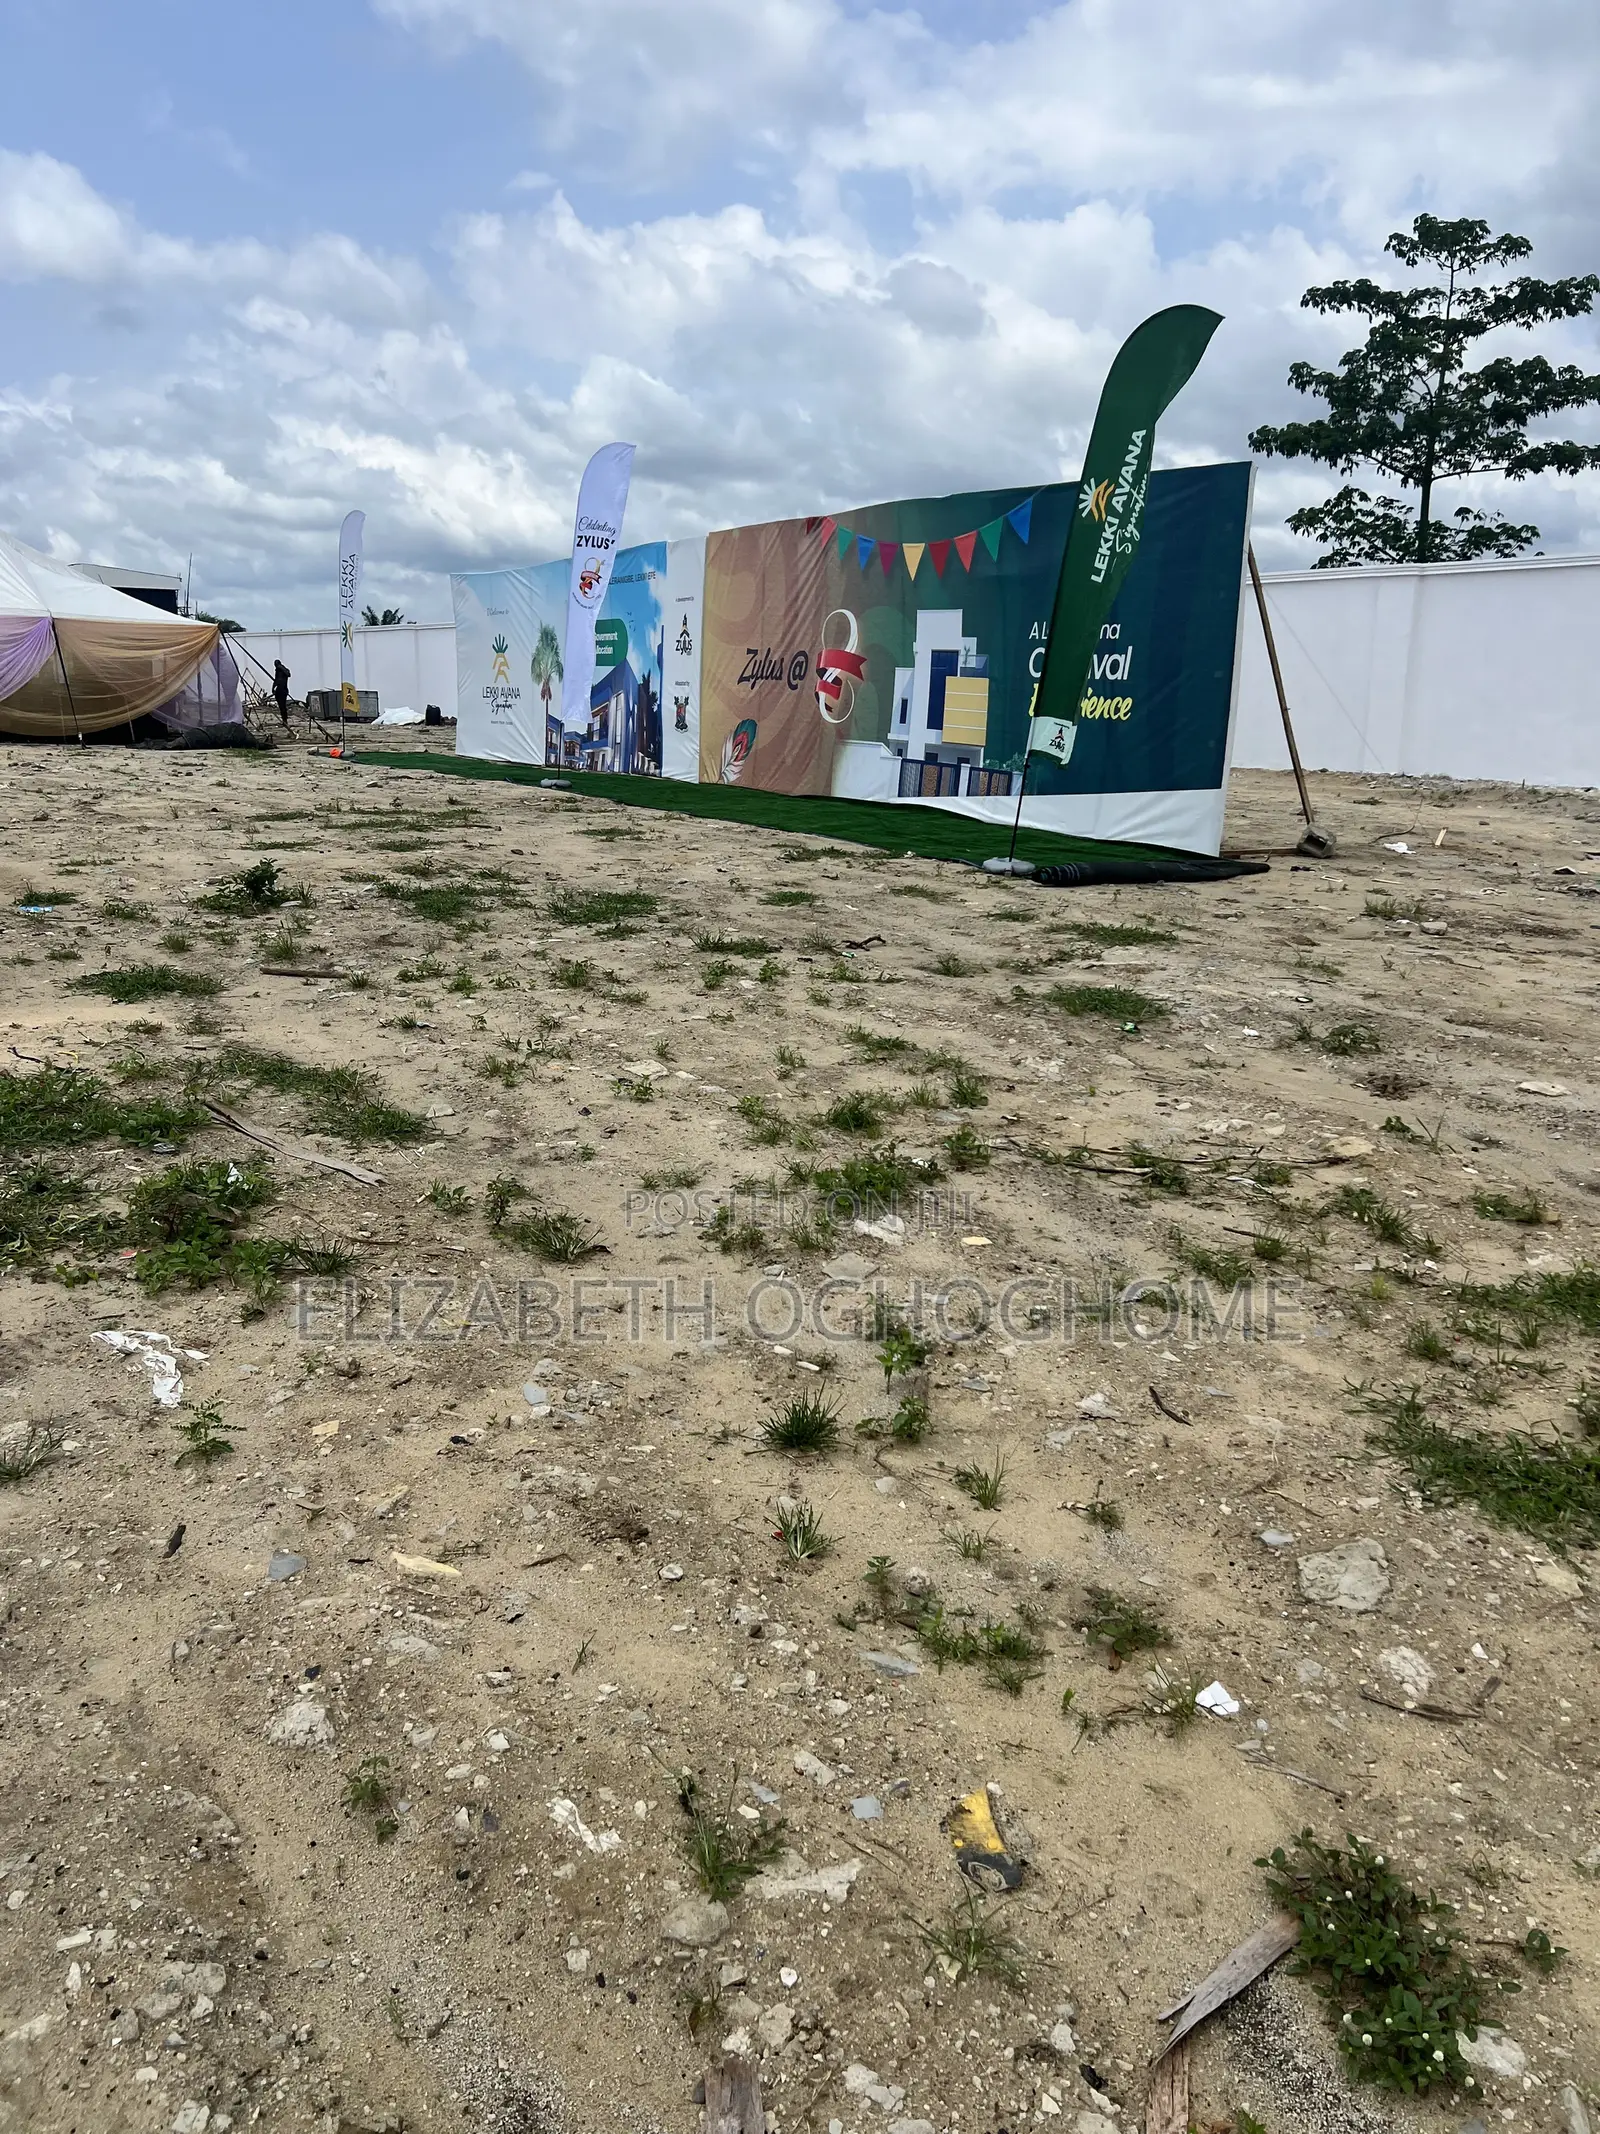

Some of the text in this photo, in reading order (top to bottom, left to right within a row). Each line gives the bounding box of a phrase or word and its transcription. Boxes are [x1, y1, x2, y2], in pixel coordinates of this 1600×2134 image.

[578, 516, 616, 537] Celebrating
[1090, 429, 1147, 583] LEKKI AVANA
[341, 559, 349, 608] LEKKI
[348, 553, 356, 610] AVANA
[1028, 621, 1040, 640] A
[737, 647, 809, 691] Zylus @
[482, 686, 521, 699] LEKKI AVANA
